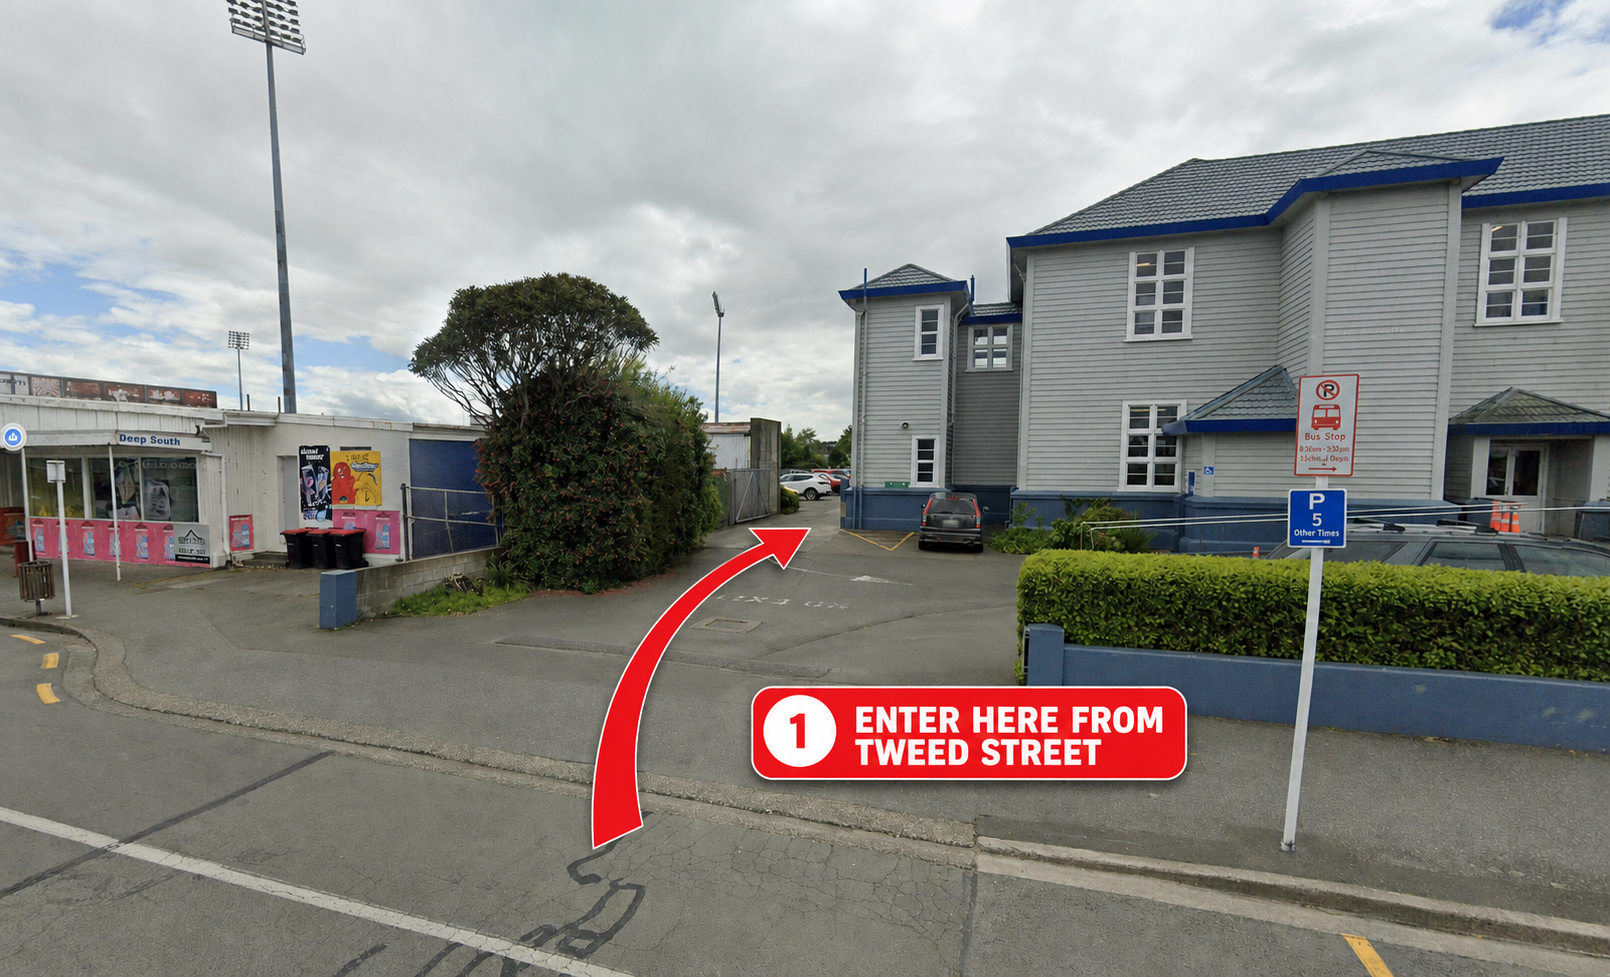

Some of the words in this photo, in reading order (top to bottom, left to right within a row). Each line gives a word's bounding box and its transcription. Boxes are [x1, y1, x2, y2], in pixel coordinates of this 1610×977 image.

[119, 433, 147, 445] Deep
[150, 435, 181, 446] South
[1304, 432, 1321, 441] Bus
[1325, 432, 1346, 442] Stop
[1309, 492, 1326, 510] P
[1312, 512, 1322, 527] 5
[1294, 528, 1316, 537] Other
[1317, 529, 1340, 537] Times
